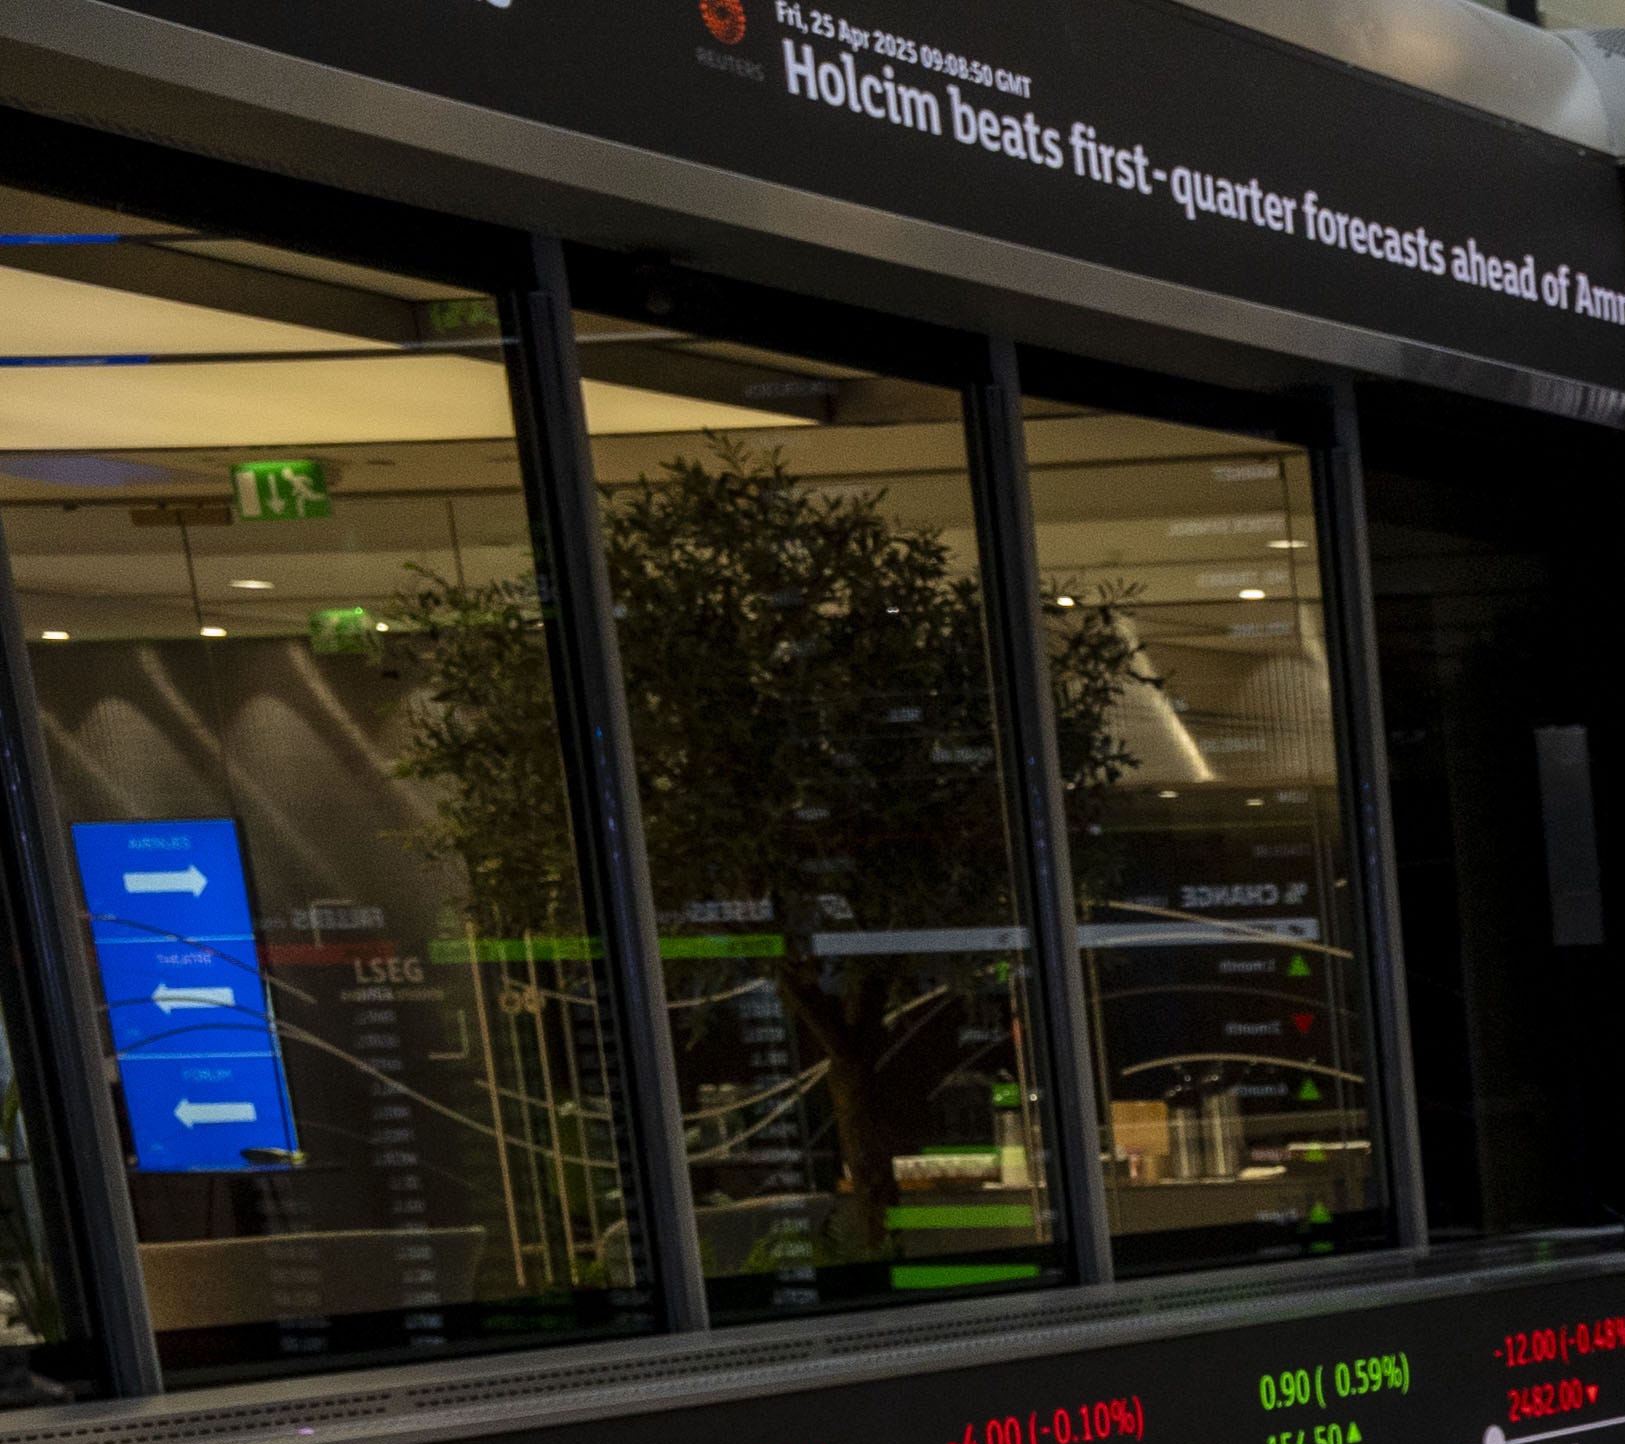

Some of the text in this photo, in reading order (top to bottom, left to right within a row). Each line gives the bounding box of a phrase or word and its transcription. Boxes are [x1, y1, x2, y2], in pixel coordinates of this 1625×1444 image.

[810, 10, 835, 38] 25
[838, 19, 870, 51] Apr
[873, 30, 918, 64] 2025
[995, 68, 1033, 99] GMT
[781, 38, 942, 136] Holcim
[946, 84, 1064, 169] beats
[1068, 121, 1297, 234] first-quarter
[1301, 190, 1447, 276] forecasts
[1451, 237, 1539, 302] ahead
[1541, 264, 1570, 310] of
[354, 957, 424, 984] LSEG
[1494, 1328, 1558, 1368] -12.00
[1259, 1368, 1311, 1411] 0.90
[1507, 1377, 1584, 1423] 2482.00
